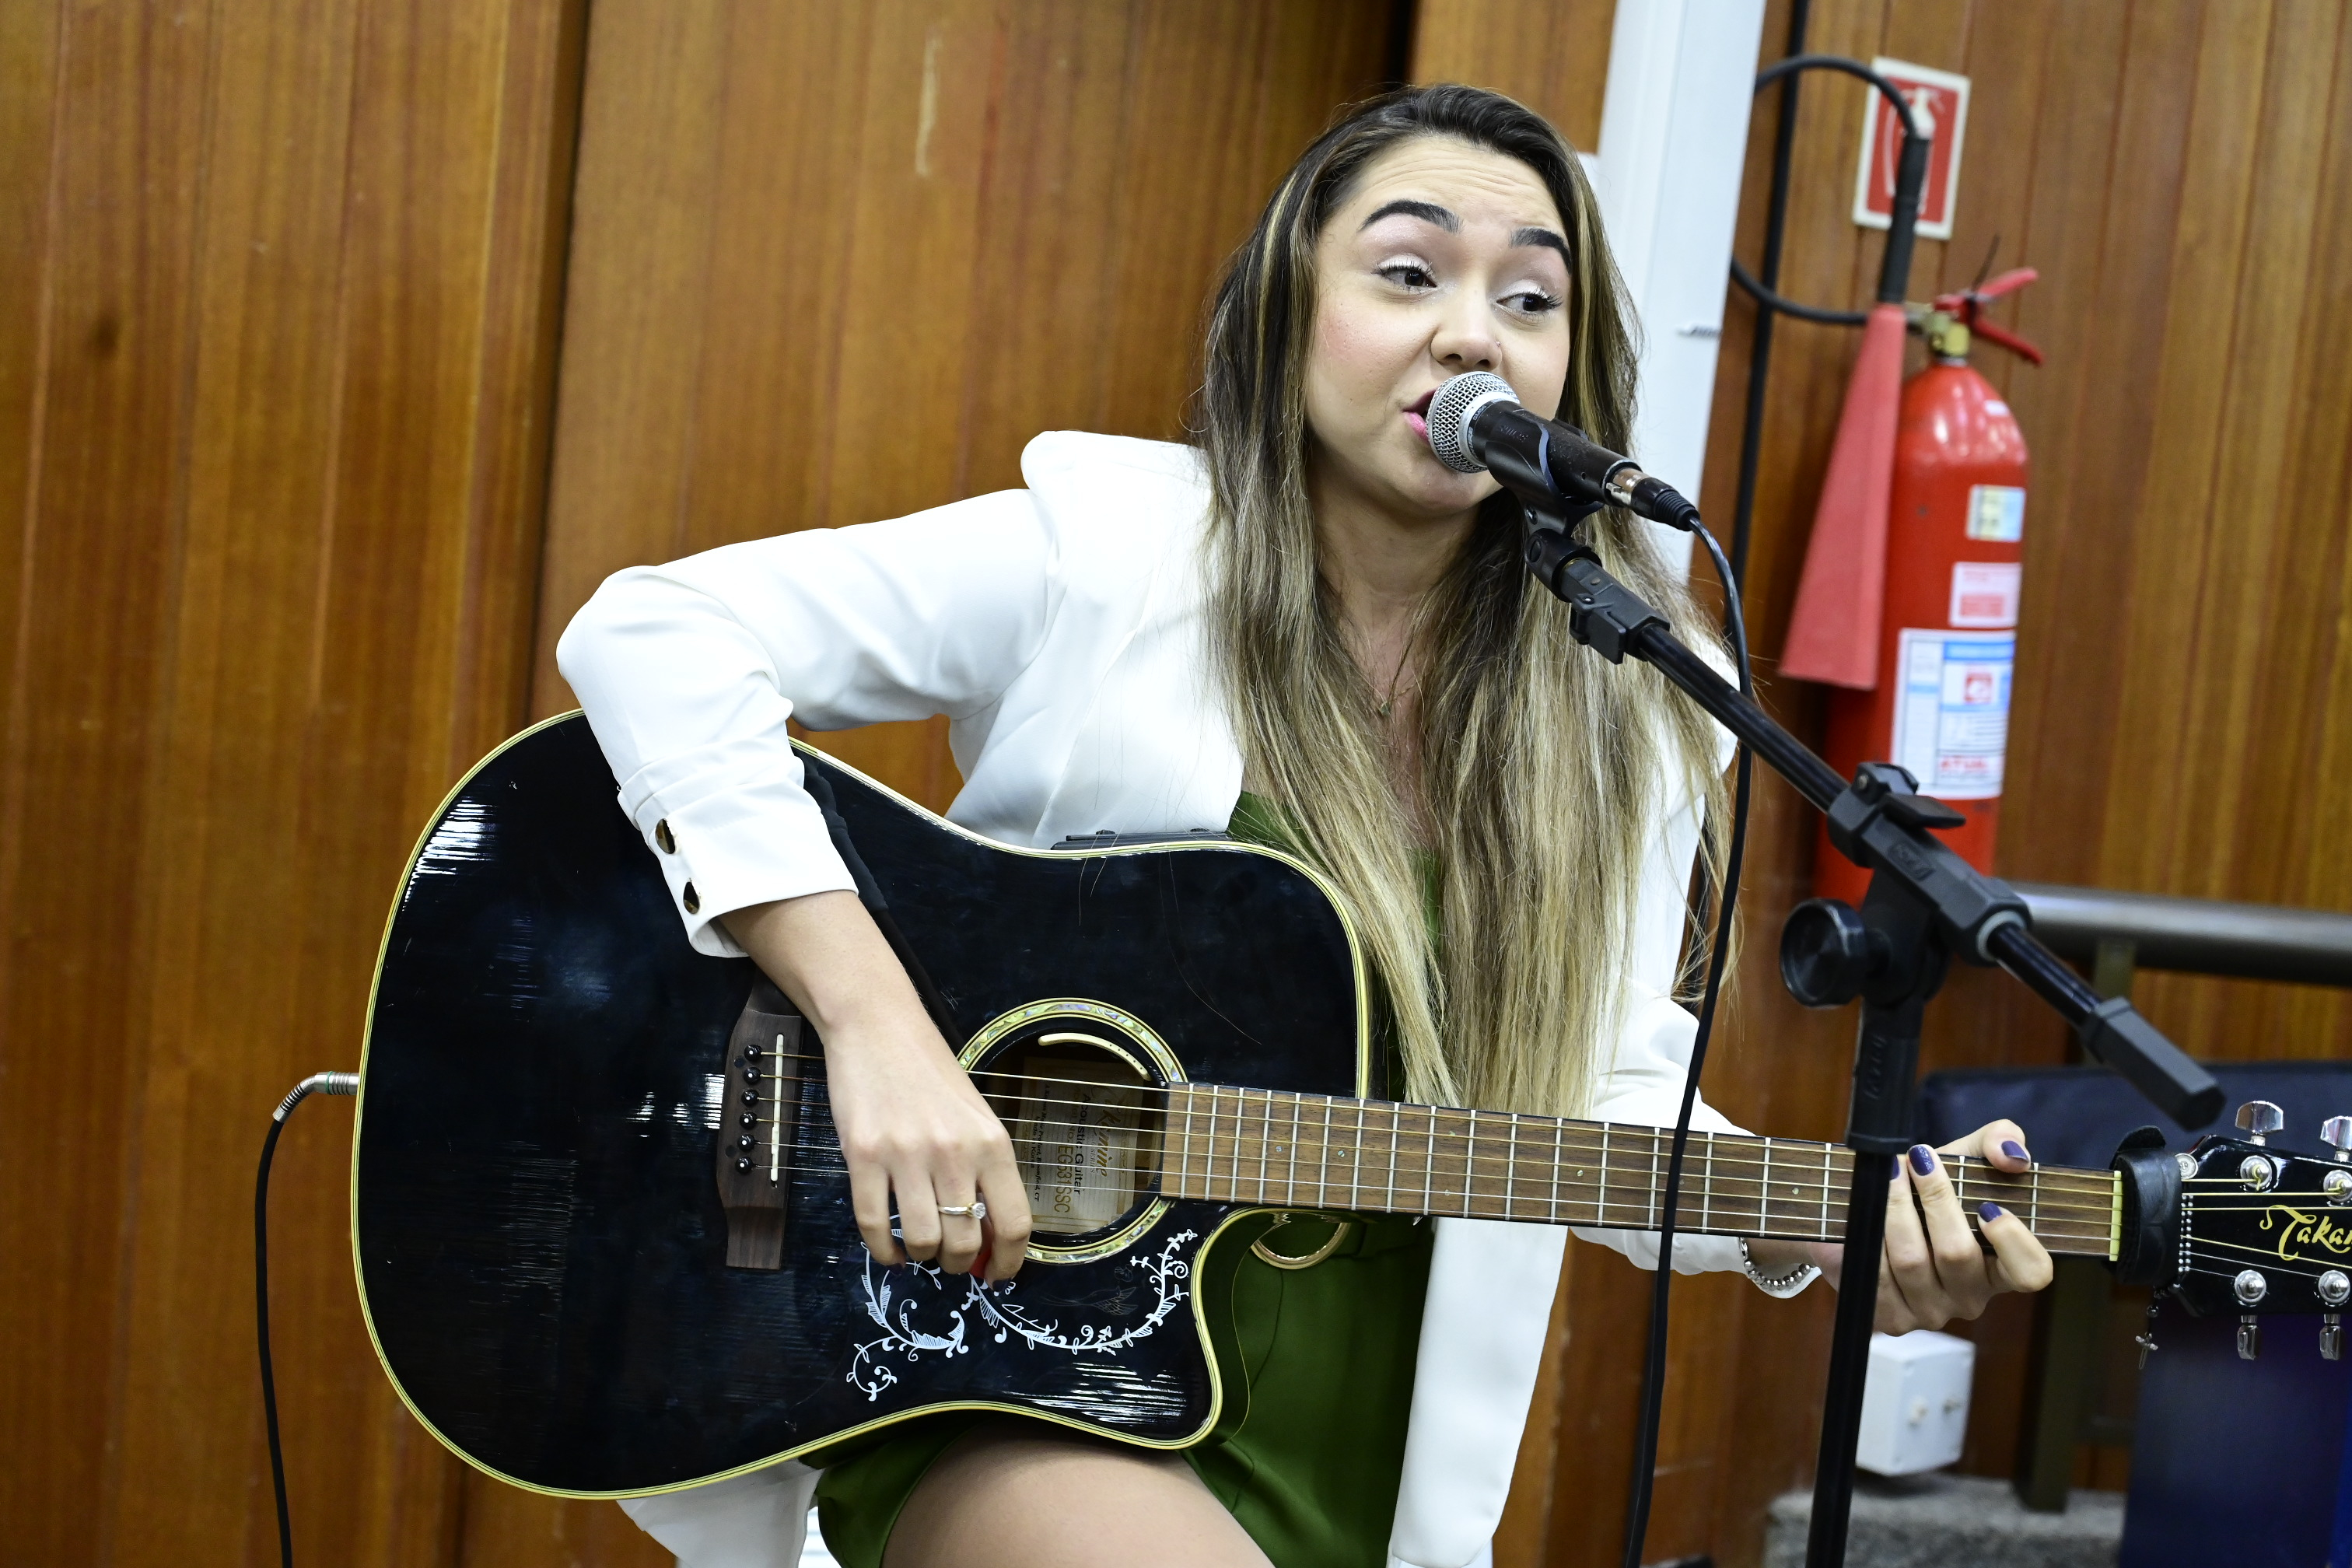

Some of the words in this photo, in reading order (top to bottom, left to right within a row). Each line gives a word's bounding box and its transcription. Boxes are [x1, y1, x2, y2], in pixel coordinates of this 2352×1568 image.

[1076, 1094, 1090, 1149] Acoustic
[1053, 1146, 1073, 1213] EG531SSC
[1074, 1153, 1083, 1195] Guitar
